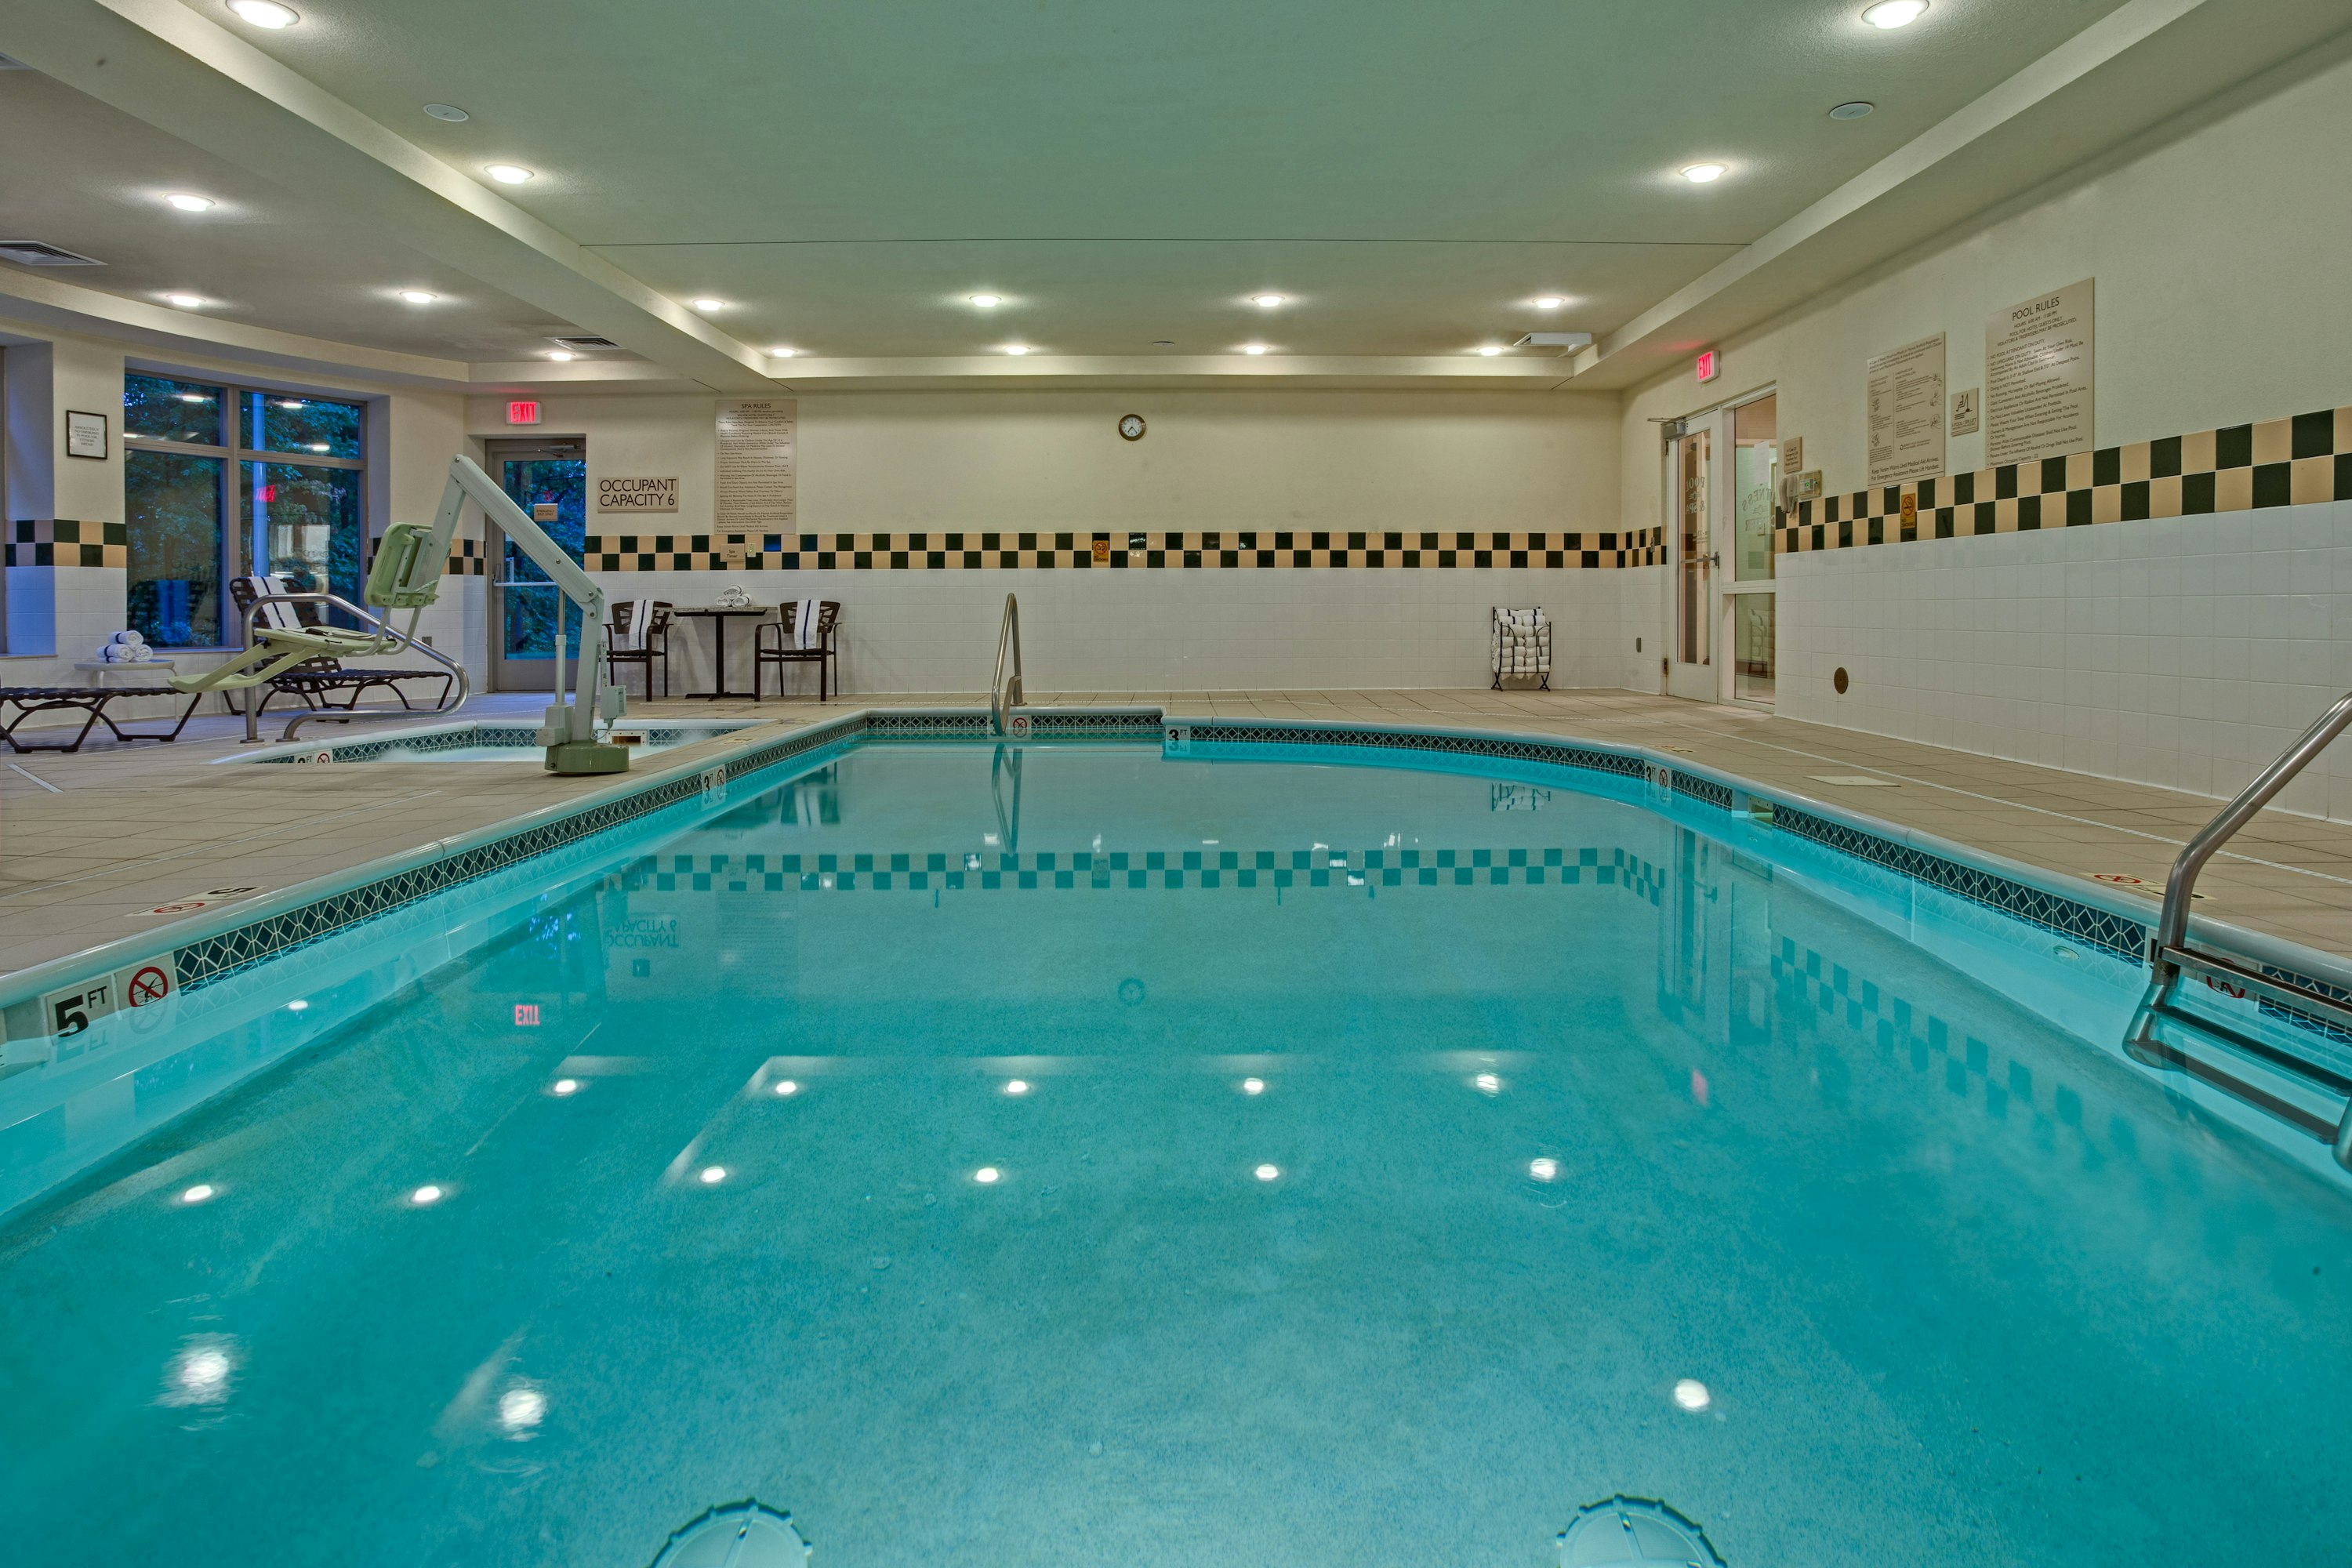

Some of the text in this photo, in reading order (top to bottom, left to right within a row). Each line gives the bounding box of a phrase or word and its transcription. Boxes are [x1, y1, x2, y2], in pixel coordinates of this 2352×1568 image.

[2012, 297, 2060, 321] POOL RULES
[1698, 353, 1711, 379] EXIT
[510, 402, 536, 422] EXIT
[600, 479, 676, 492] OCCUPANT
[600, 494, 675, 506] CAPACITY 6
[1169, 729, 1179, 741] 3
[1646, 766, 1651, 783] 3
[704, 776, 710, 791] 3
[55, 986, 107, 1037] 5 FT
